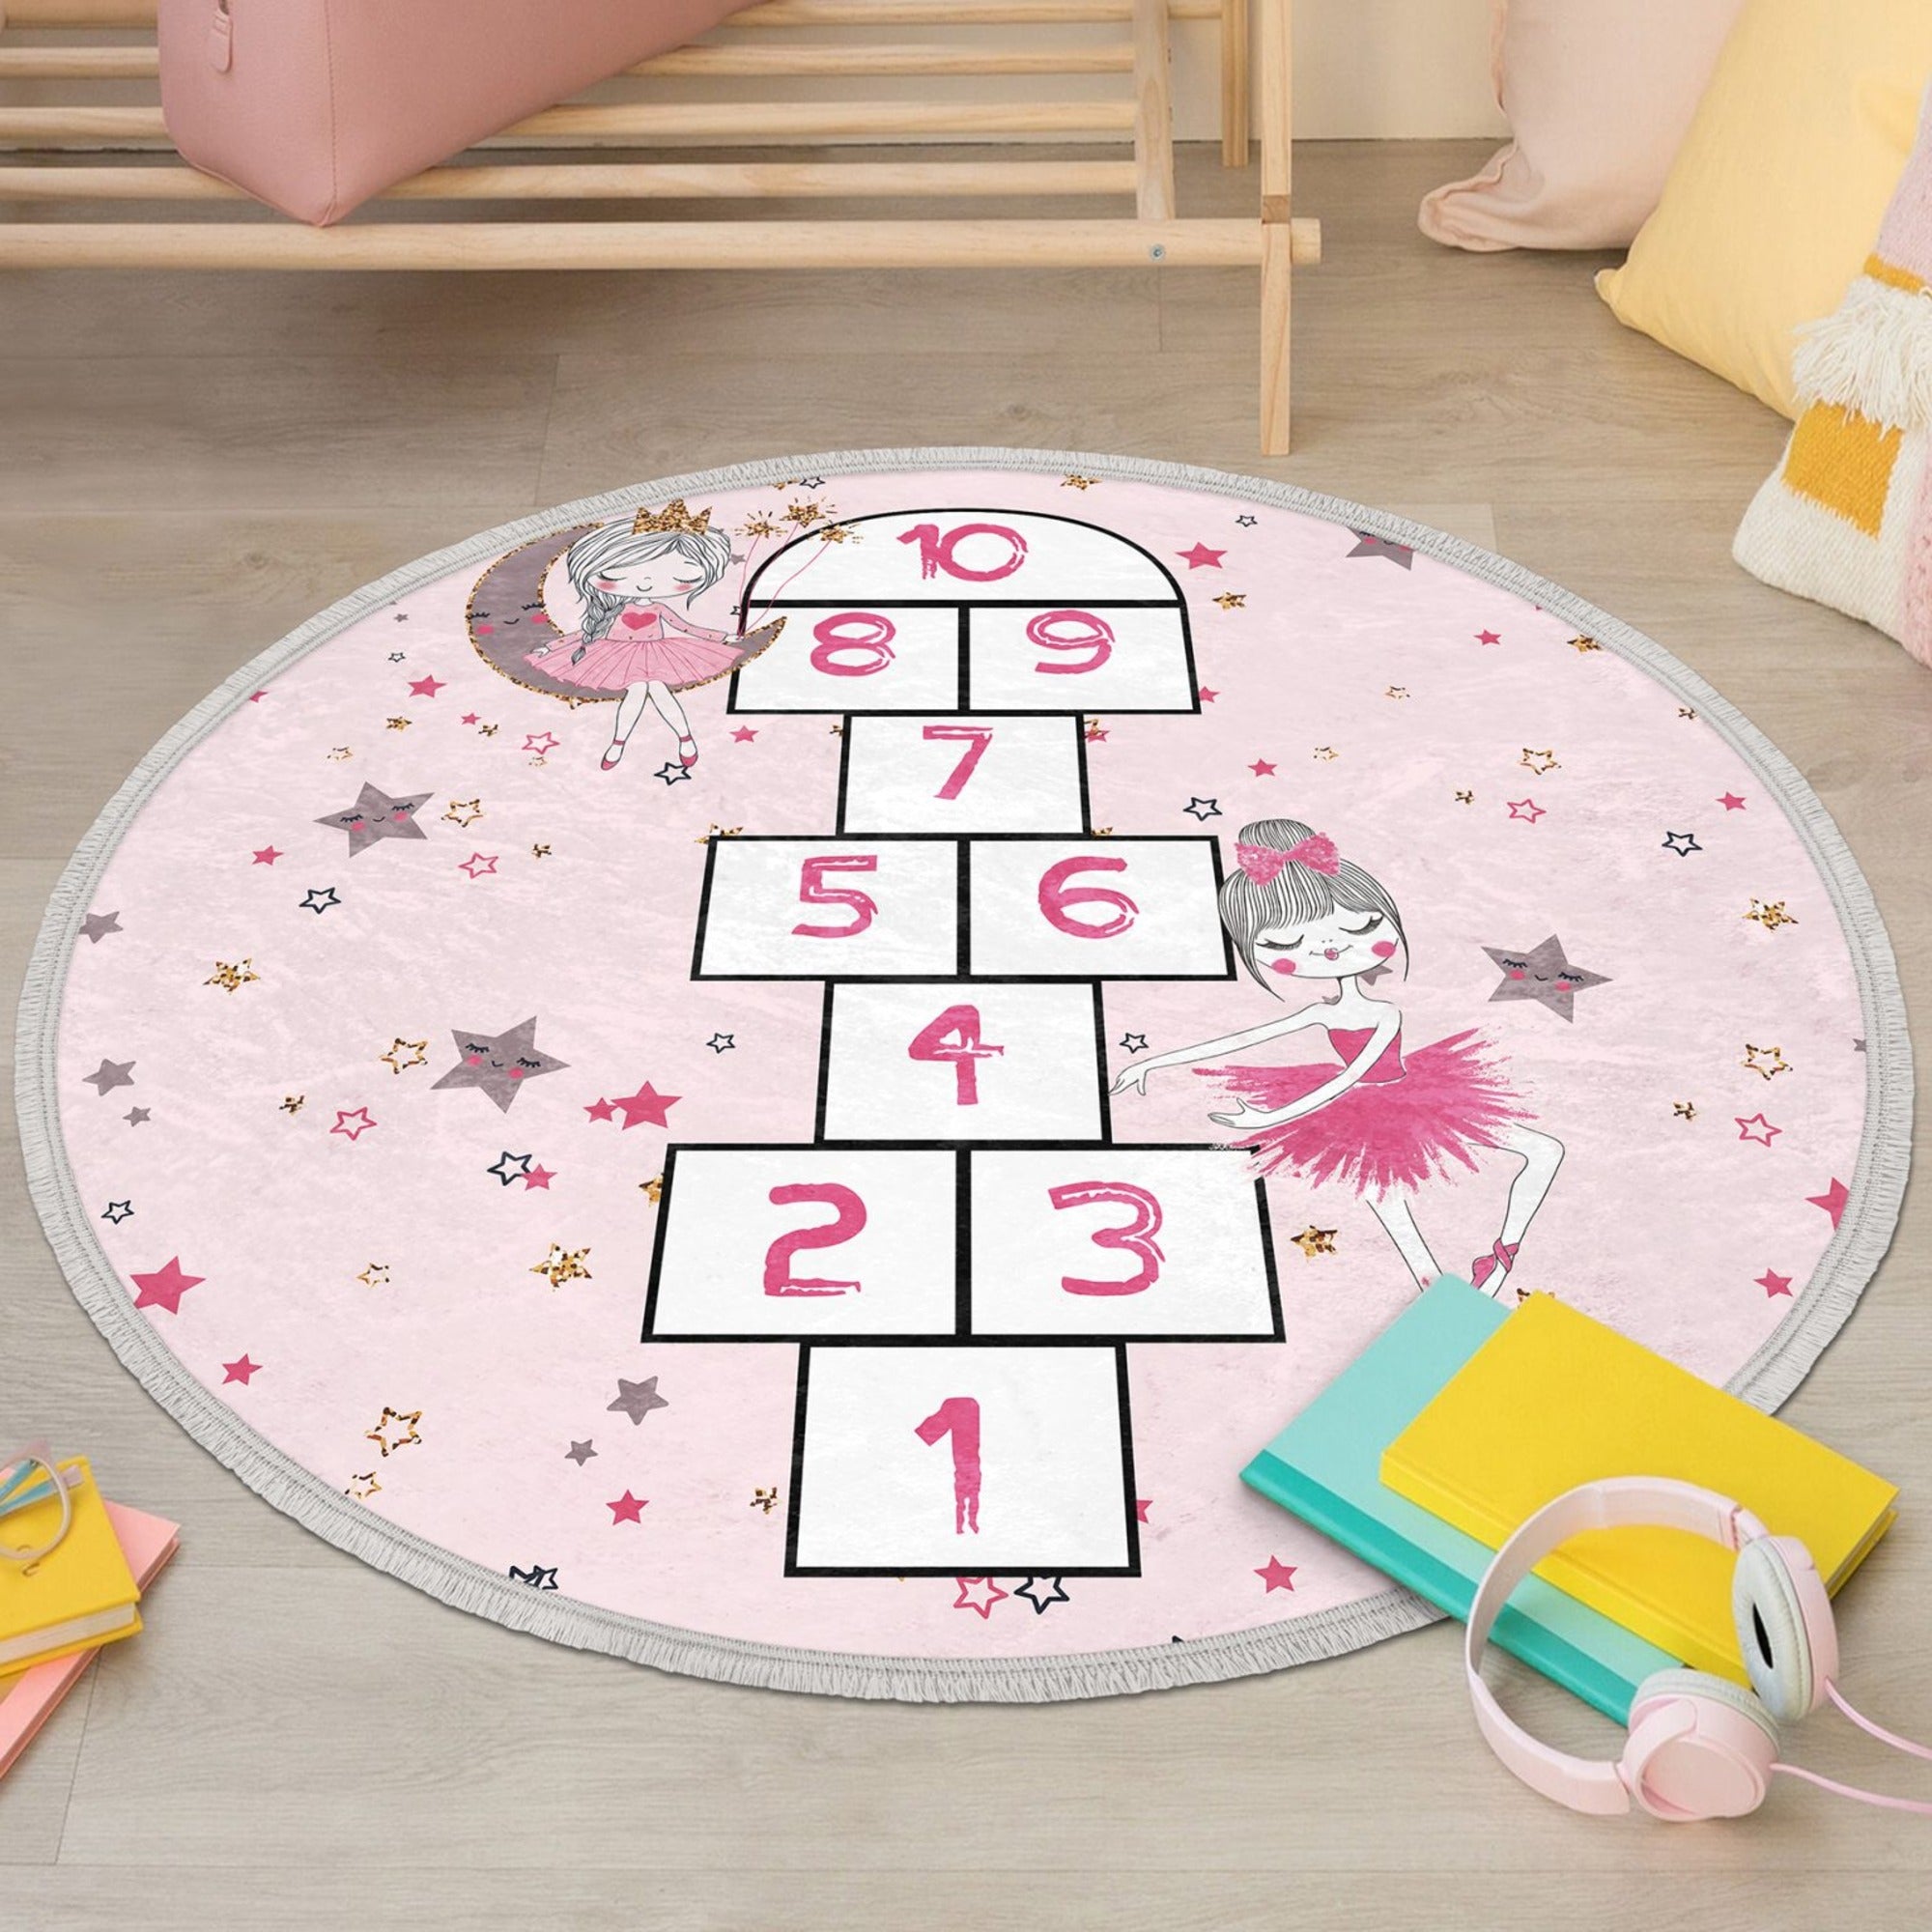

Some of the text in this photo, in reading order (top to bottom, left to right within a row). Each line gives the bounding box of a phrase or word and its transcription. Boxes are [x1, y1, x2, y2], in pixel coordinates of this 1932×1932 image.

[897, 524, 1027, 582] 10
[810, 612, 895, 676] 8
[1026, 611, 1115, 674] 9
[923, 725, 992, 800] 7
[792, 855, 878, 938] 5
[1038, 856, 1139, 939] 6
[908, 1005, 1004, 1105] 4
[763, 1183, 867, 1296] 2
[1048, 1181, 1165, 1296] 3
[915, 1397, 981, 1534] 1
